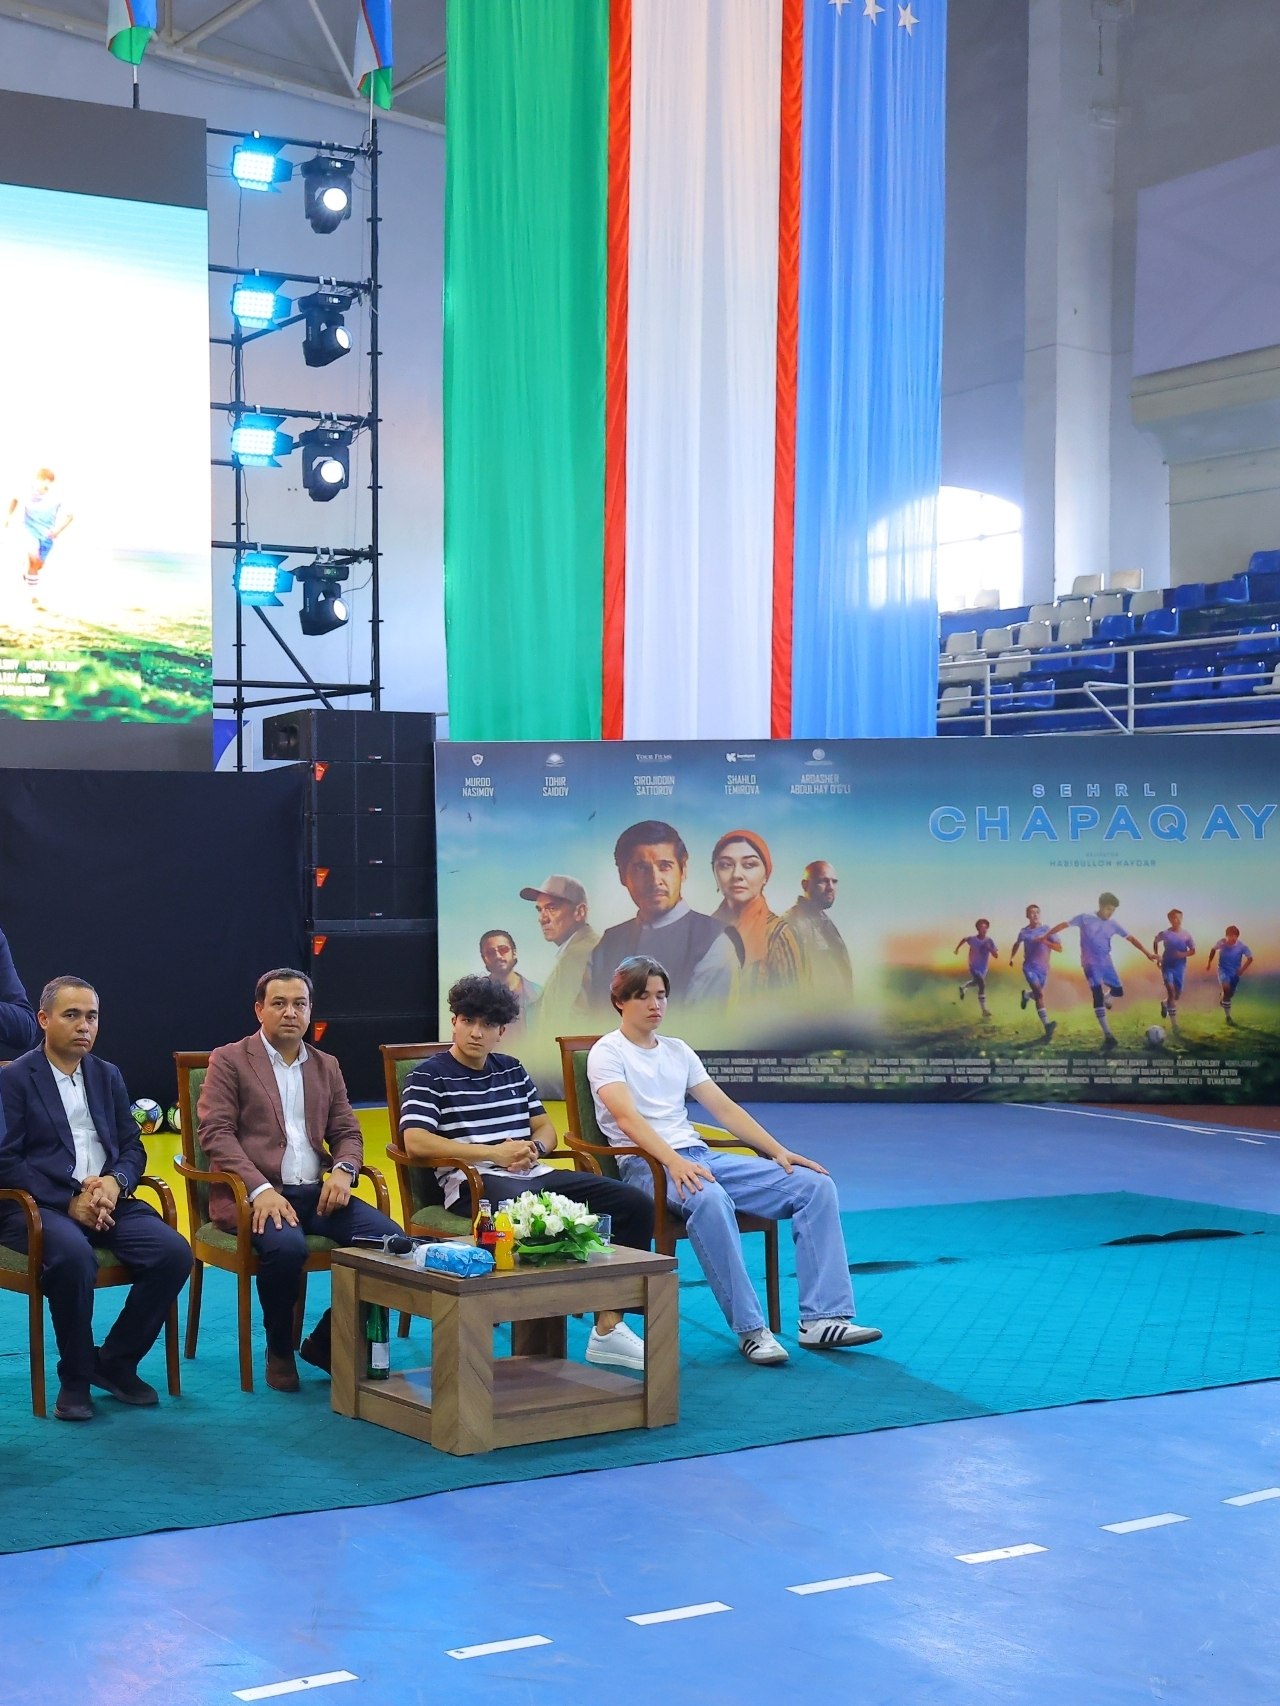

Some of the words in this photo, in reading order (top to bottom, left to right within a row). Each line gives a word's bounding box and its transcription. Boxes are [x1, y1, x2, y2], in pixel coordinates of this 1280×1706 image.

[465, 777, 491, 787] MUROD
[544, 776, 566, 787] TOHIR
[633, 775, 675, 786] SIROJIDDIN
[727, 774, 756, 785] SHAHLO
[462, 787, 494, 797] NASIMOV
[542, 787, 569, 797] SAIDOV
[636, 785, 673, 796] SATTOROV
[724, 784, 760, 795] TEMIROVA
[1032, 783, 1178, 798] SEHRLI
[928, 804, 1279, 844] CHAPAQAY
